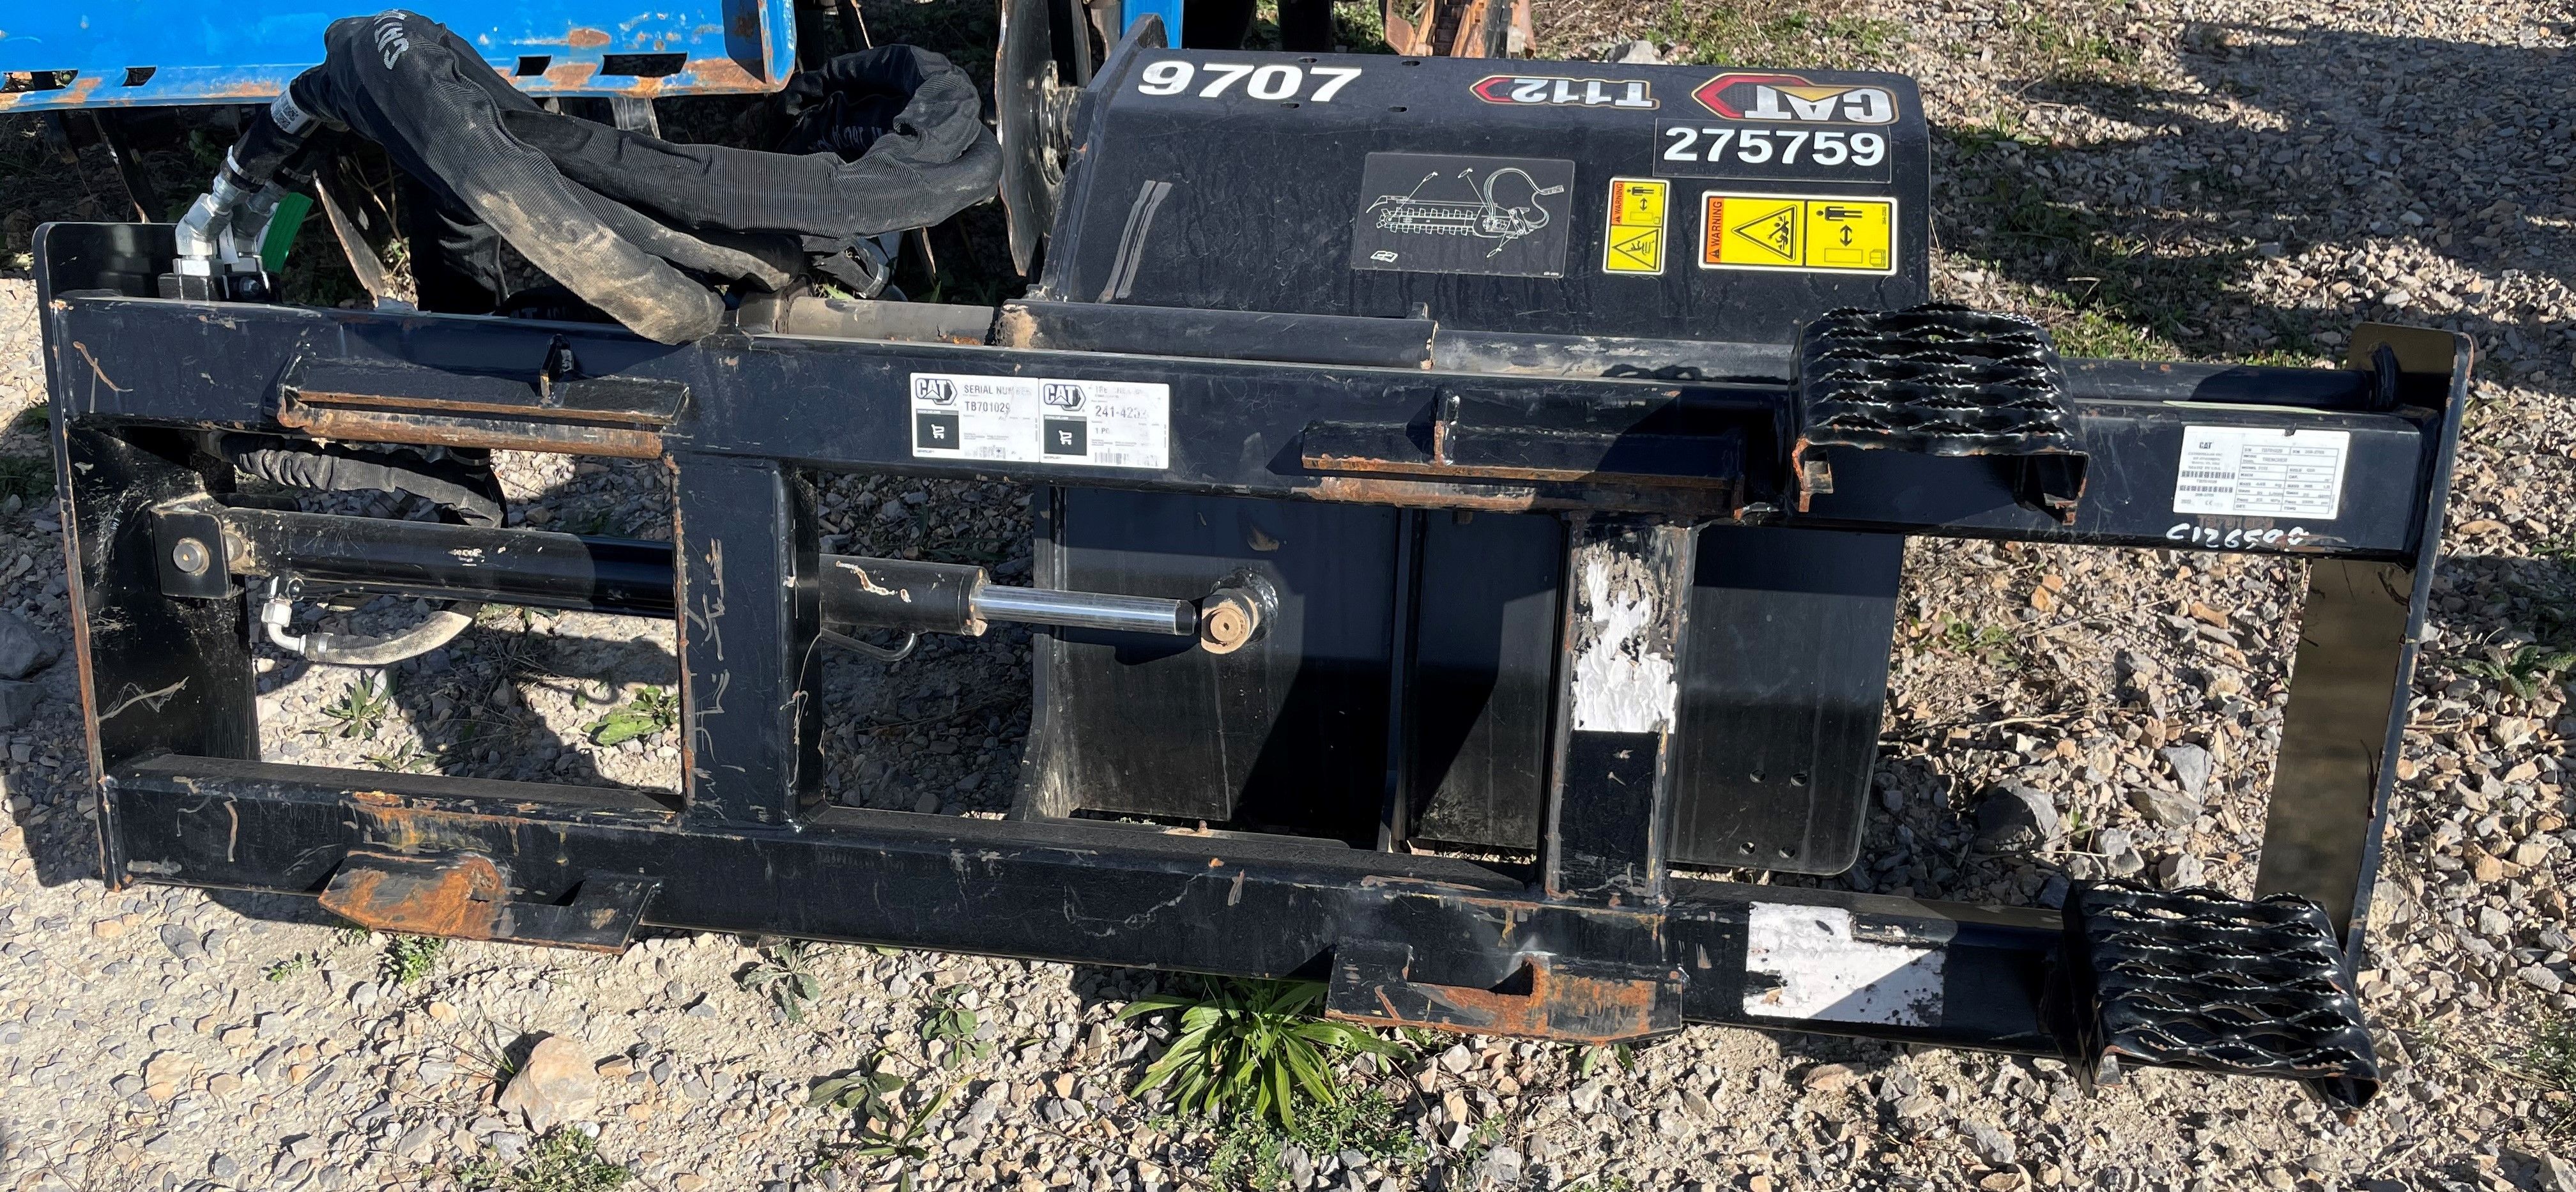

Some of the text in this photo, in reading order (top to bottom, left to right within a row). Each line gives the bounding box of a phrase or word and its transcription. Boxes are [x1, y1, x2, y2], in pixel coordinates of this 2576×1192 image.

[1138, 60, 1362, 102] 9707
[1511, 78, 1653, 107] T112
[1744, 85, 1892, 123] CAT
[1663, 126, 1885, 167] 275759
[1614, 183, 1623, 214] WARNING
[1710, 201, 1722, 247] WARNING
[916, 378, 947, 401] CAT
[963, 385, 993, 395] SERIAL
[1044, 383, 1075, 406] CAT
